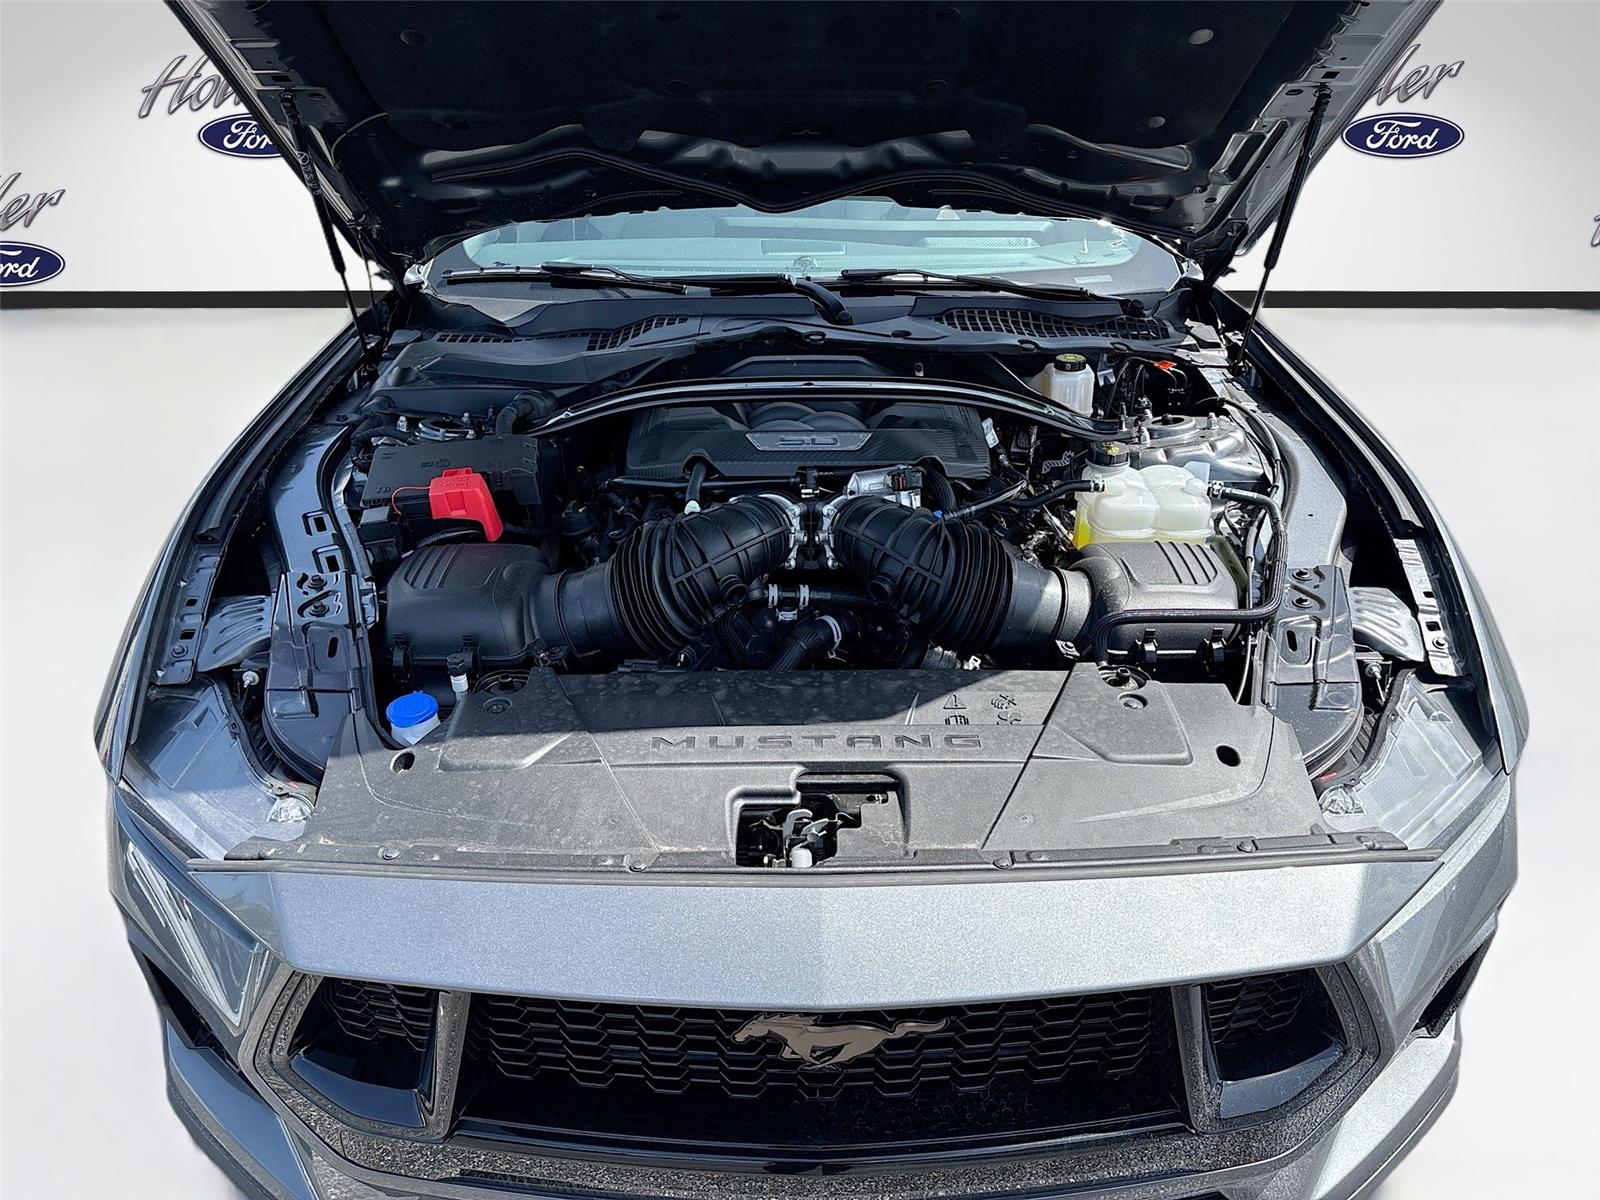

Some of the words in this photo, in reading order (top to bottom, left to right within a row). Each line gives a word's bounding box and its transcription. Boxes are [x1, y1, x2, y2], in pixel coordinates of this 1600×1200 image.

[223, 119, 273, 150] For
[1366, 120, 1440, 149] Ford
[650, 734, 983, 750] MUSTANG
